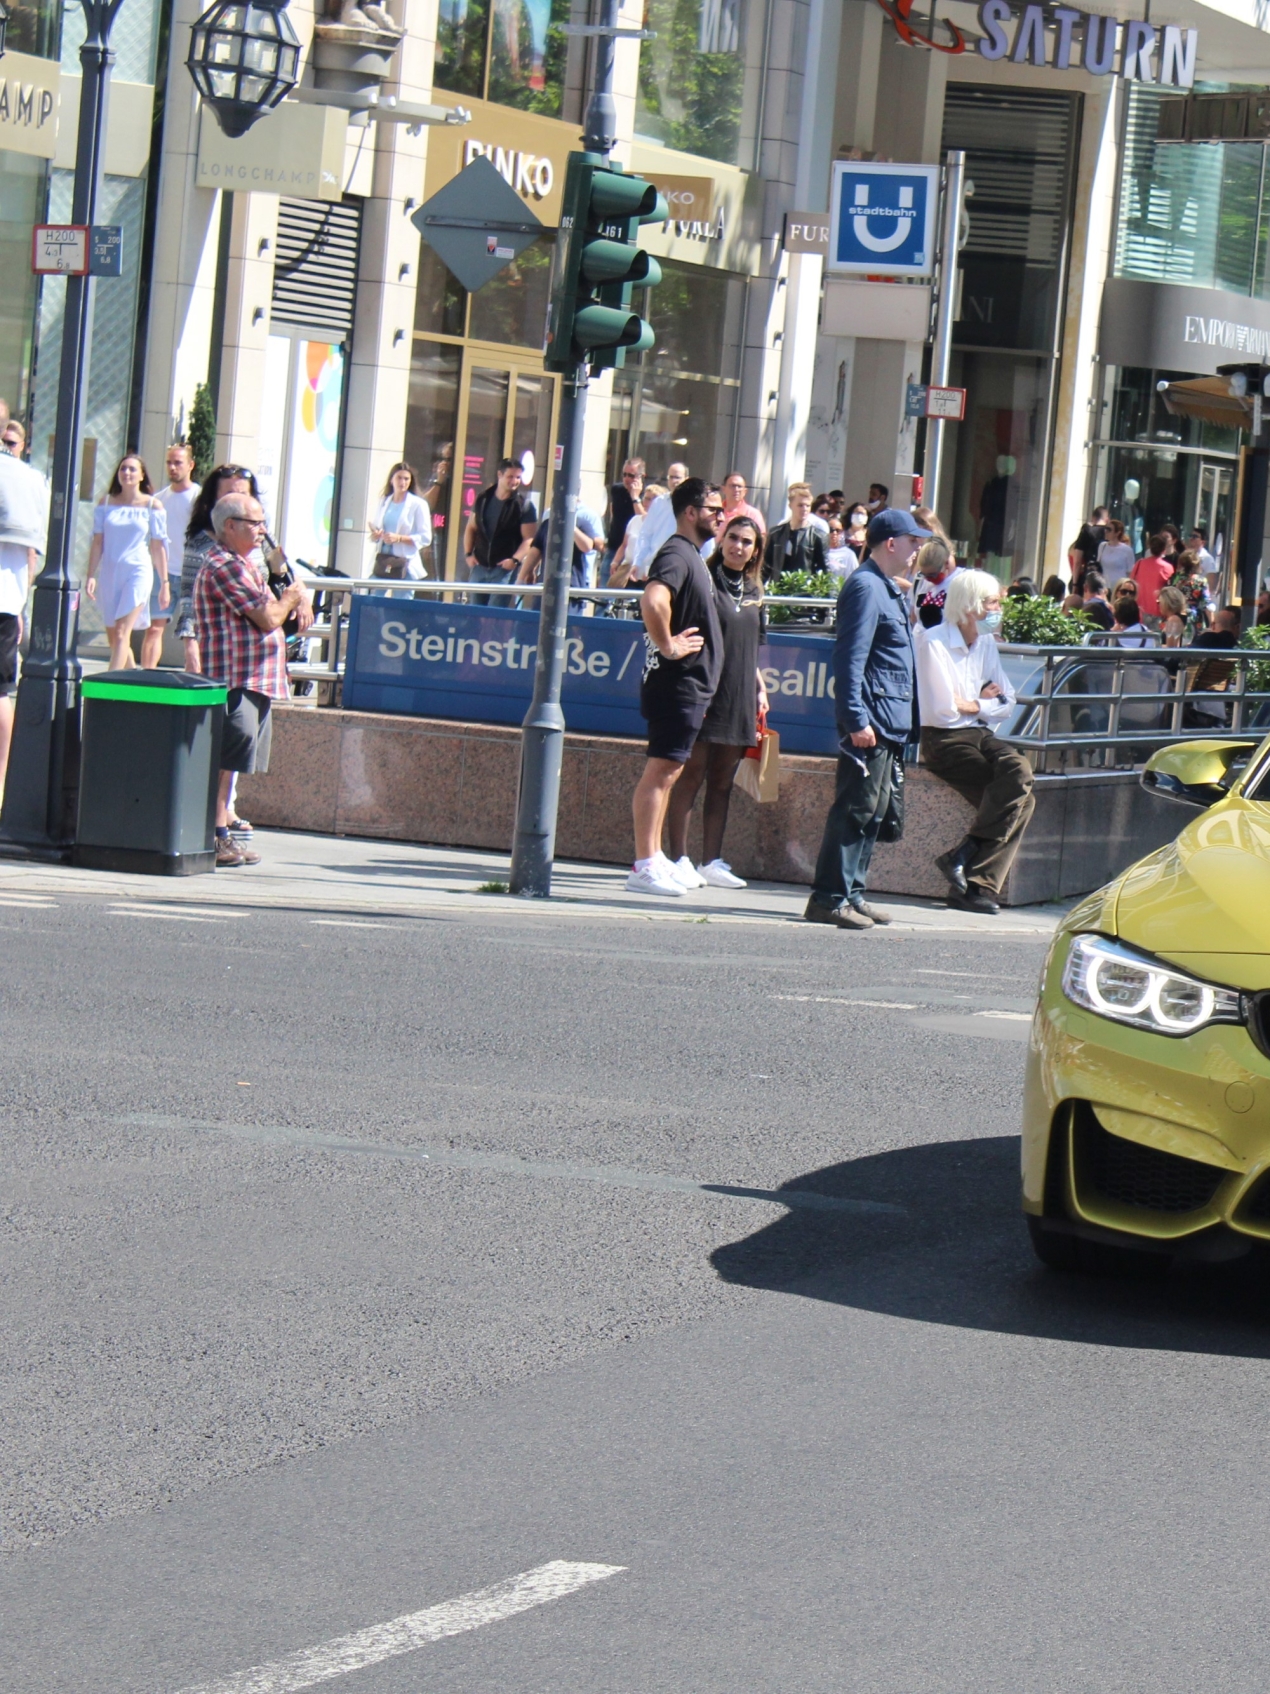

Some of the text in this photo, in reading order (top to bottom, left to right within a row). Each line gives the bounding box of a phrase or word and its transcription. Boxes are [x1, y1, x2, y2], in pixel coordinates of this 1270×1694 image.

[978, 0, 1198, 88] SATURN
[200, 162, 316, 184] LONGCHAMP
[848, 206, 917, 218] stadtbahn
[46, 230, 75, 242] H200
[378, 620, 611, 678] Steinstrße
